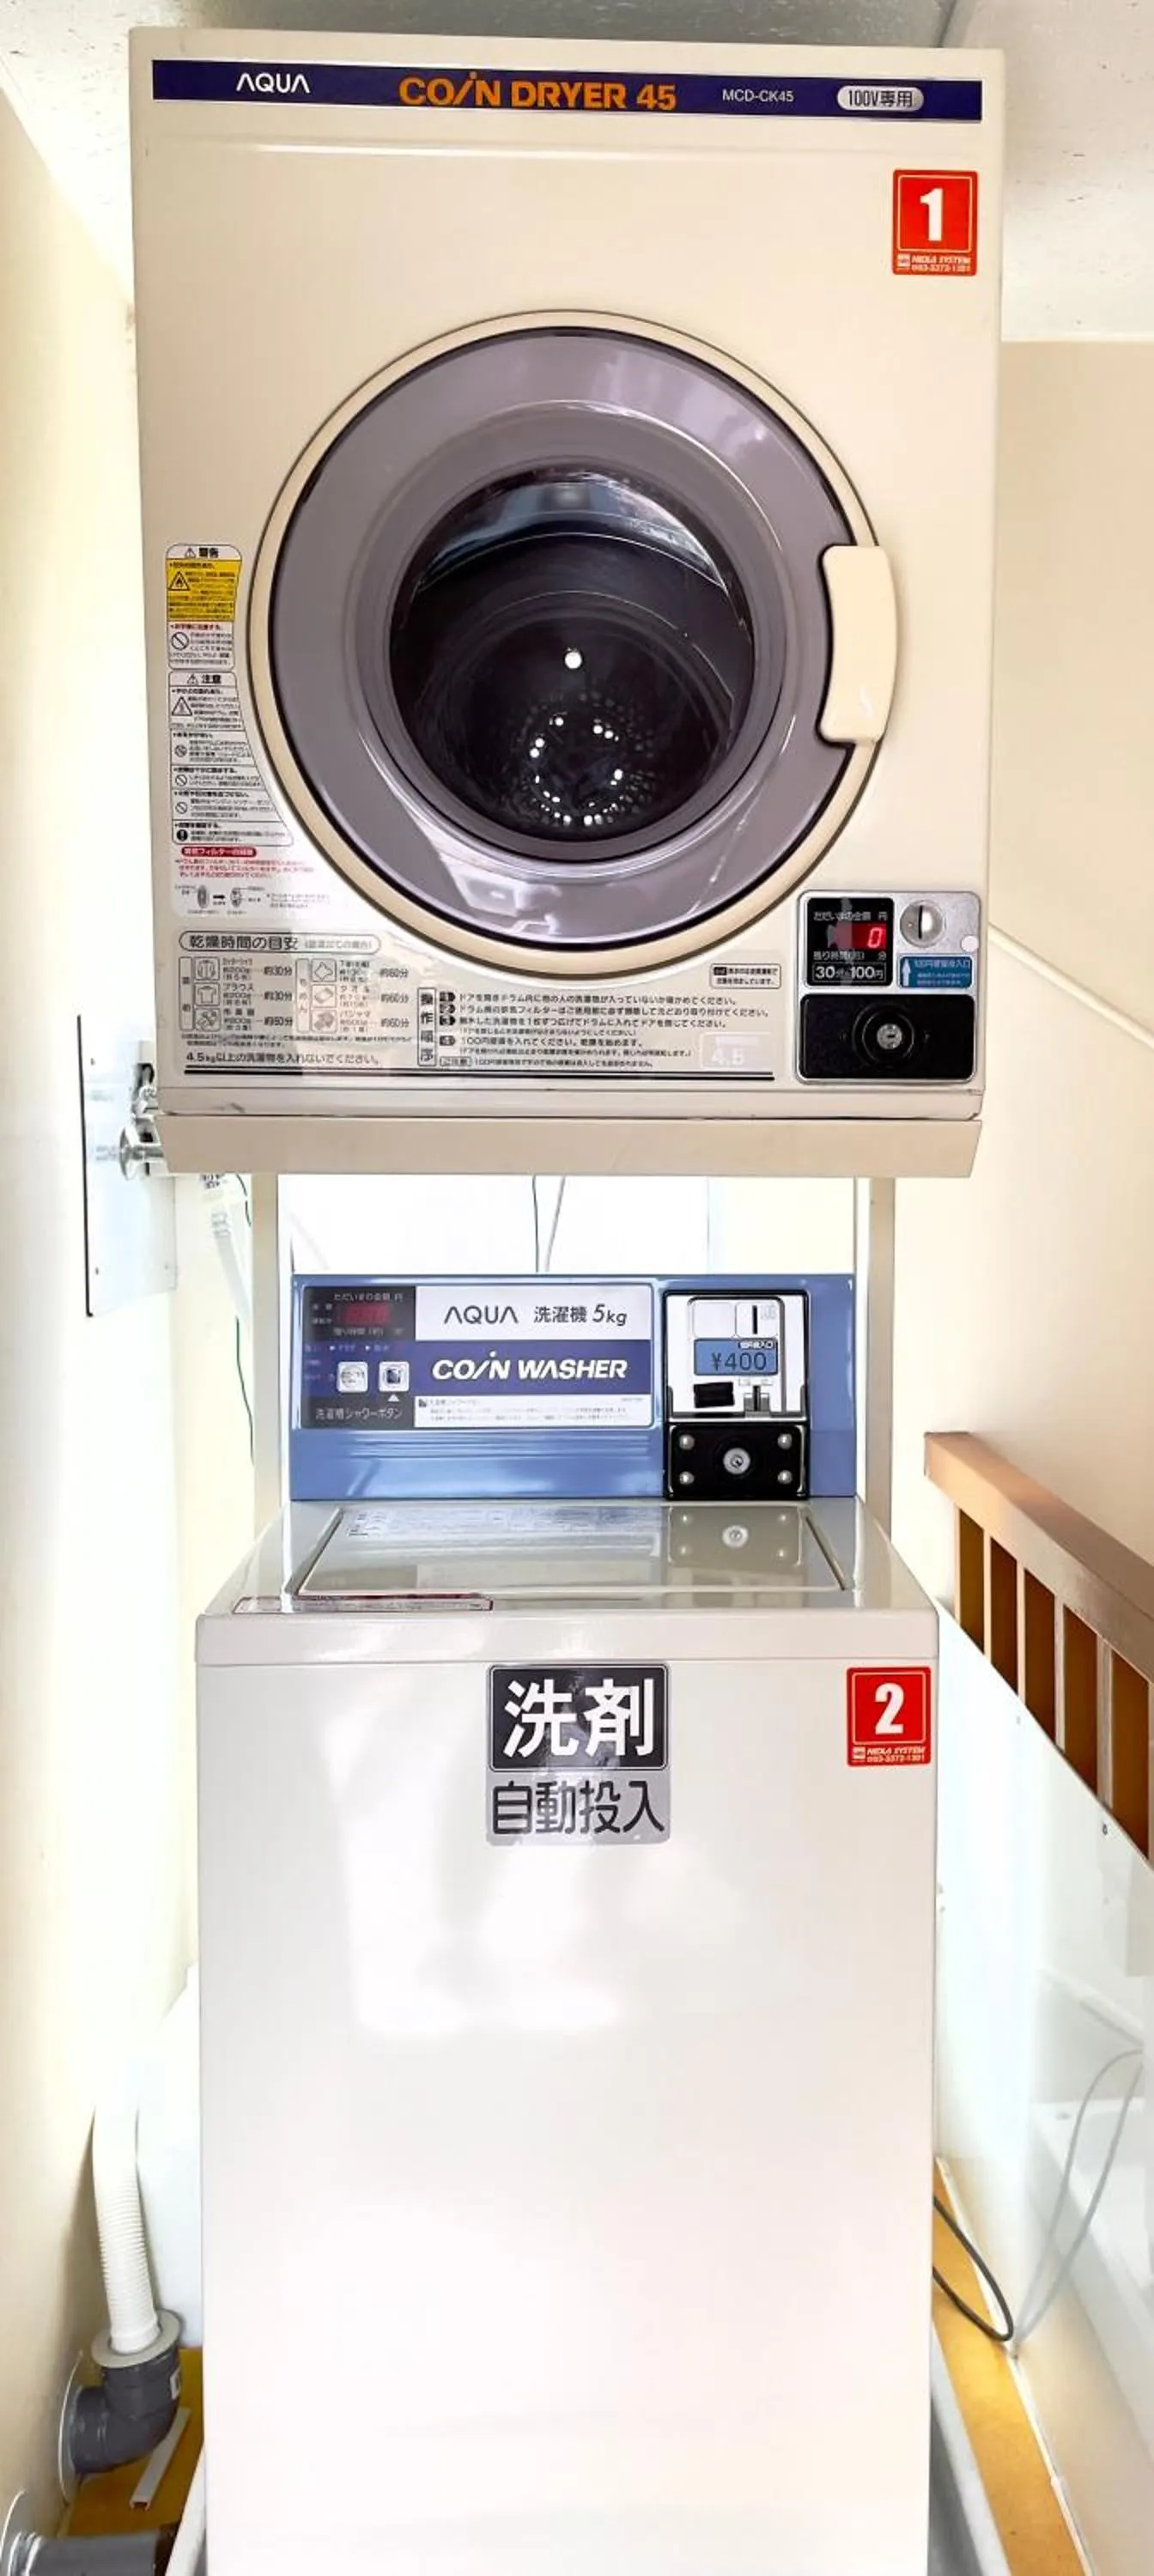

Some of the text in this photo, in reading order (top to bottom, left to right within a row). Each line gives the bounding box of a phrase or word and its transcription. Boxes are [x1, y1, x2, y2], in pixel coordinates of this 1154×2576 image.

[236, 72, 310, 94] AQUA
[398, 71, 677, 111] COIN DRYER 45
[722, 88, 794, 104] MCD-CK45
[847, 88, 914, 108] 100V専用
[920, 188, 944, 241] 1
[198, 547, 219, 558] 警告
[202, 674, 221, 683] 注意
[190, 935, 299, 951] 乾燥時間の目安
[867, 927, 883, 949] 0
[444, 1304, 519, 1325] AQUA
[534, 1303, 628, 1327] 洗濯機 5kg
[433, 1351, 629, 1381] COIN WASHER
[711, 1352, 767, 1371] ¥400
[503, 1678, 656, 1759] 洗剤
[873, 1682, 905, 1735] 2
[492, 1779, 665, 1836] 自動投入
